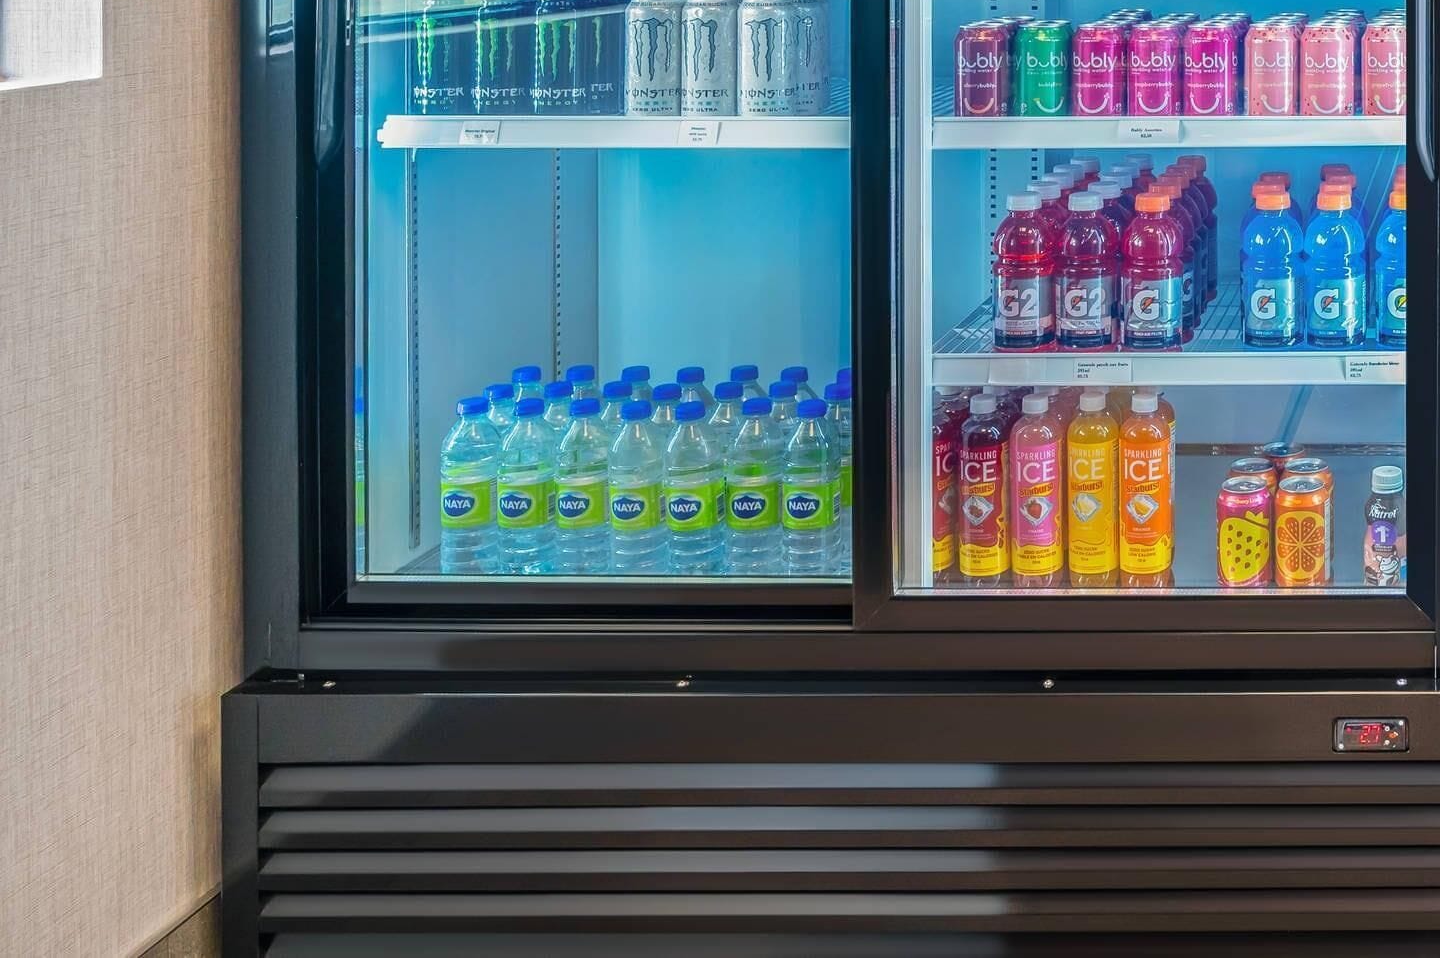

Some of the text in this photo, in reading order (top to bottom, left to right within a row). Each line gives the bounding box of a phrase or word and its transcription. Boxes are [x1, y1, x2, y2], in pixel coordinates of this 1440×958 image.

[957, 51, 1003, 72] bubly
[1073, 51, 1118, 72] bubly
[1131, 51, 1176, 72] bubly
[1185, 51, 1226, 72] bubly
[1305, 51, 1350, 72] bubly
[1368, 51, 1406, 70] bubl
[682, 88, 729, 98] ONSTER
[1000, 288, 1040, 317] G2
[1064, 288, 1106, 317] G2
[1132, 289, 1160, 321] G
[1250, 288, 1277, 320] G
[1313, 288, 1341, 320] G
[960, 449, 997, 460] SPARKLING
[1016, 448, 1056, 460] SPARKLING
[1123, 448, 1162, 459] SPARKLING
[935, 452, 953, 477] IC
[960, 460, 997, 483] ICE
[1016, 459, 1056, 484] ICE
[1068, 458, 1106, 480] ICE
[1124, 458, 1164, 481] ICE
[444, 498, 472, 510] NAYA
[500, 499, 529, 510] NAYA
[559, 500, 587, 510] NAYA
[613, 501, 642, 513] NAYA
[670, 502, 698, 513] NAYA
[733, 500, 762, 512] NAYA
[788, 500, 817, 512] NAYA
[1368, 505, 1399, 519] Natrel
